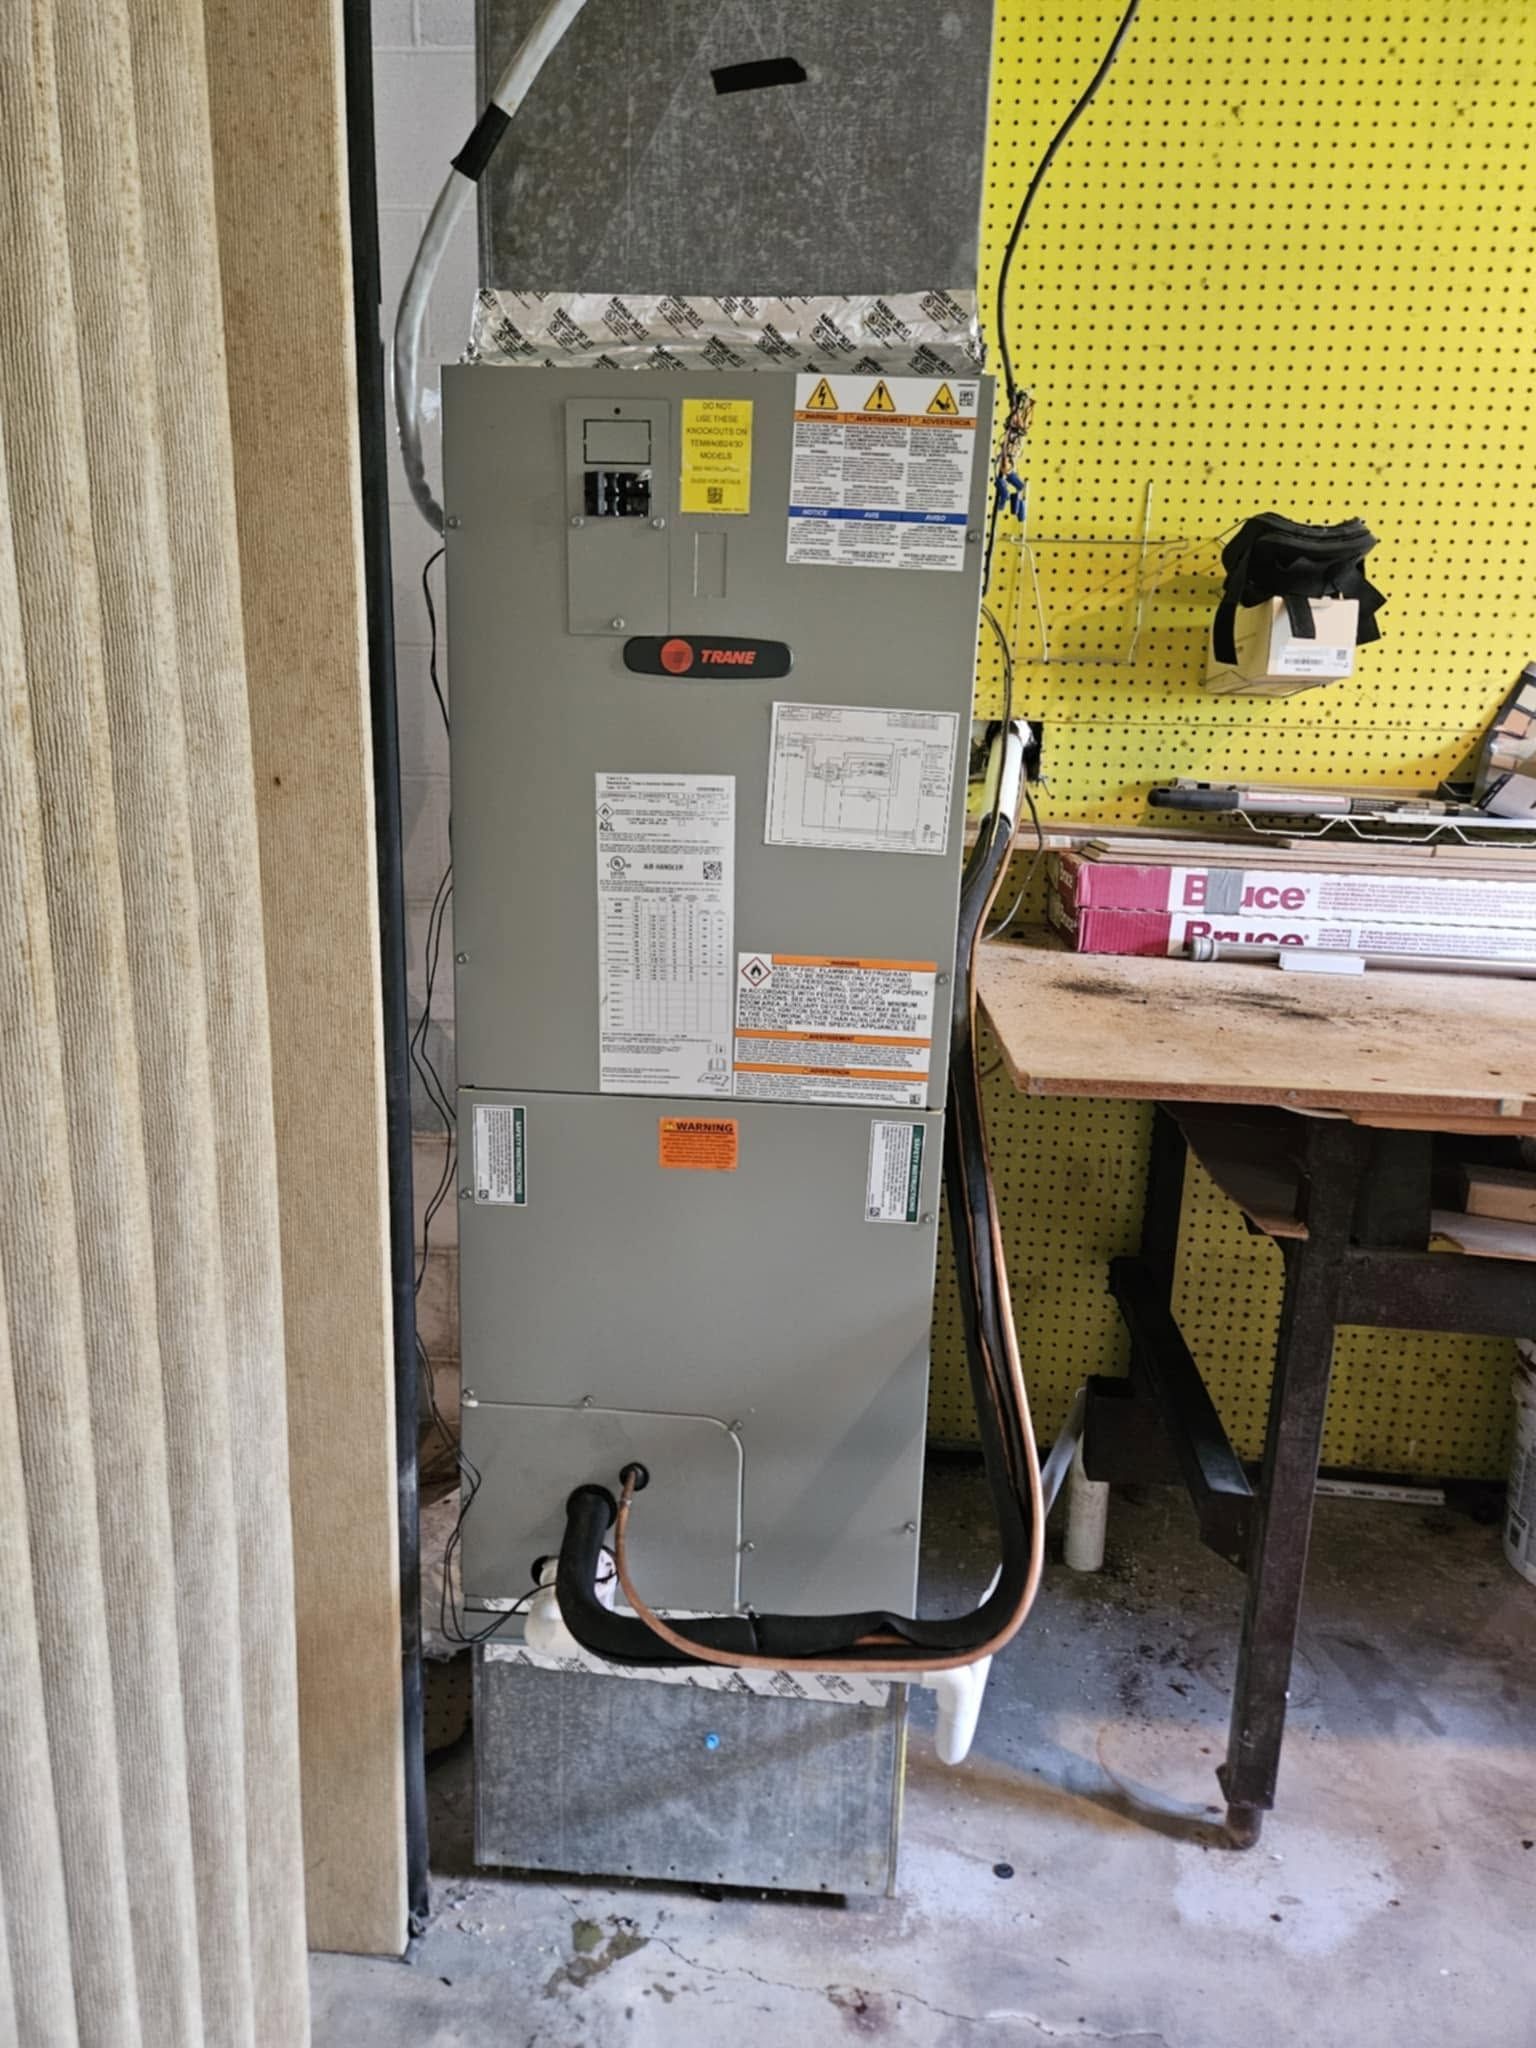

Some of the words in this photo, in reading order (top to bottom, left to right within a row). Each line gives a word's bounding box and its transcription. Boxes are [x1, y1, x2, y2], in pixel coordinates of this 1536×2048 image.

[856, 416, 907, 424] AVERTISSEMENT
[922, 418, 970, 426] ADVERTENCIA
[687, 427, 733, 436] KNOCKOUTS
[700, 452, 732, 460] MODELS
[802, 509, 829, 517] NOTICE
[925, 514, 946, 522] AVISO
[701, 650, 757, 664] TRANE
[676, 1122, 734, 1132] WARNING
[912, 1138, 920, 1164] SAFETY
